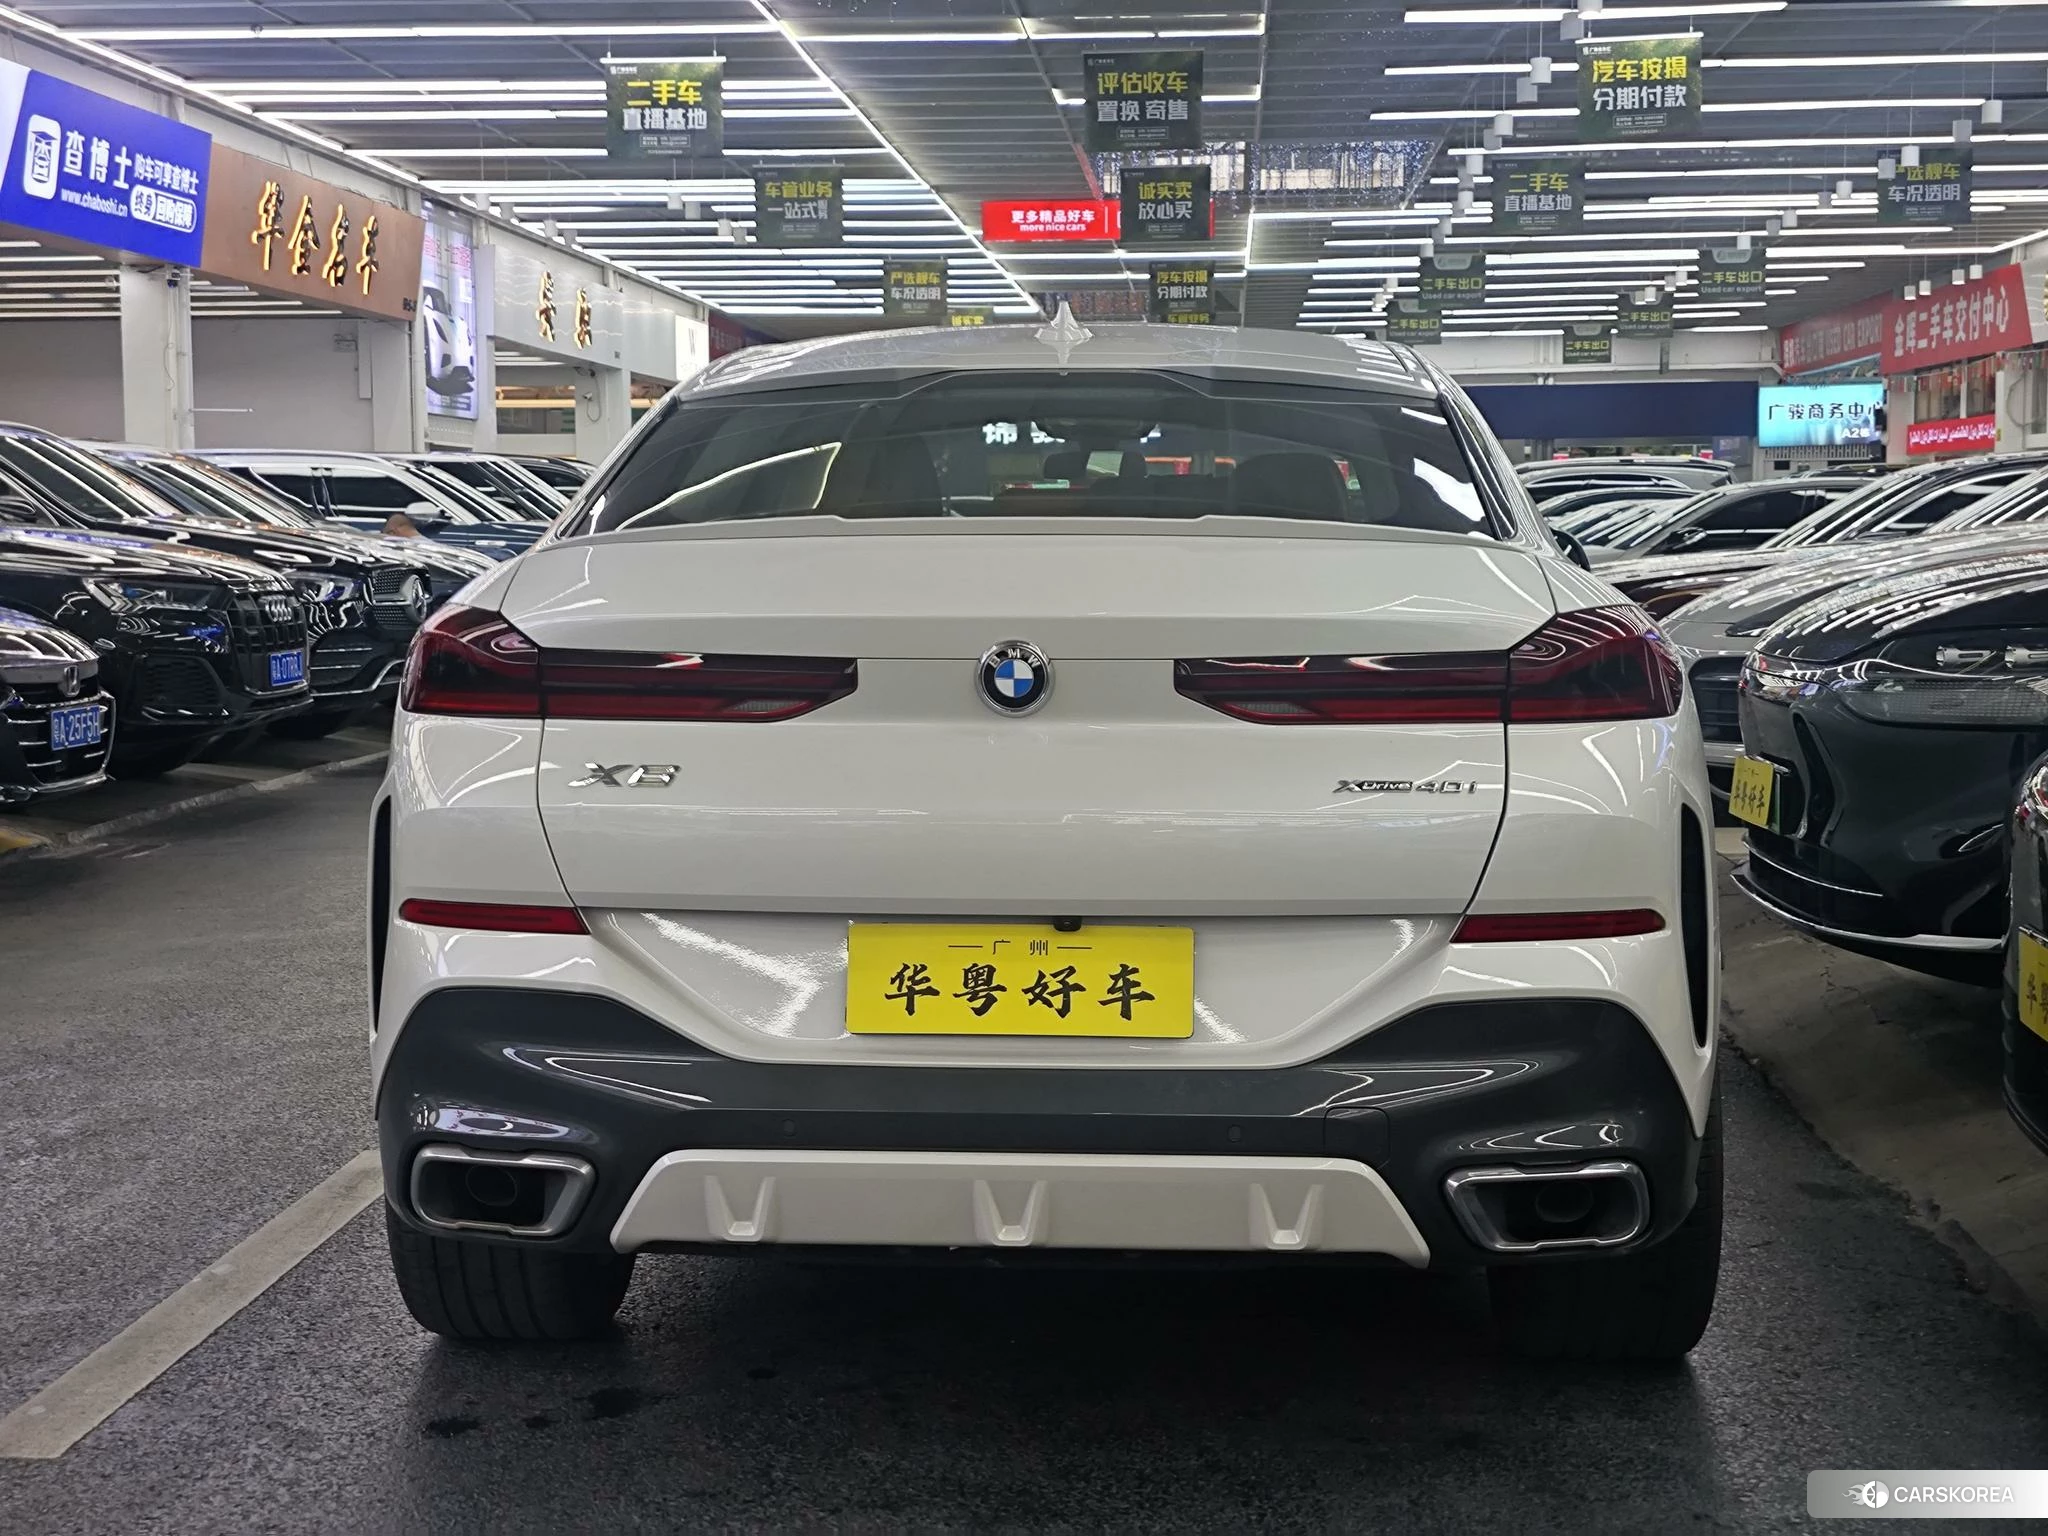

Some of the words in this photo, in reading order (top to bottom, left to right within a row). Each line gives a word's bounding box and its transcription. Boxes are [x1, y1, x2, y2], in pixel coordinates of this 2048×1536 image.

[1592, 56, 1687, 83] 汽车按揭
[1097, 71, 1189, 95] 评估收车
[626, 80, 702, 106] 二手车
[1592, 84, 1687, 111] 分期付款
[623, 108, 708, 131] 直播基地
[1097, 100, 1140, 122] 置换
[1145, 100, 1189, 121] 寄售
[63, 130, 132, 190] 查博士
[134, 153, 199, 196] 购车可享查博士
[1508, 173, 1569, 192] 二手车
[765, 181, 833, 198] 车管业务
[1138, 182, 1193, 200] 诚实卖
[1888, 183, 1961, 202] 车况透明
[61, 188, 128, 218] www.chaboshi.cn
[134, 190, 154, 216] 终身
[156, 194, 193, 228] 回购保障
[1138, 201, 1193, 220] 放心买
[1504, 194, 1572, 212] 直播基地
[1011, 210, 1095, 224] 更多精品好车
[1020, 224, 1044, 232] more
[1045, 223, 1066, 232] nice
[1066, 224, 1087, 232] cars
[1423, 277, 1482, 290] 二手车出口
[1702, 271, 1762, 283] 二手车出口
[1736, 286, 1762, 294] export
[1391, 319, 1439, 329] 二手车出口
[1621, 311, 1671, 322] 二手车出口
[1566, 340, 1609, 350] 二手车出口
[988, 648, 1041, 668] BMW
[567, 761, 681, 788] X6
[992, 939, 1049, 956] 广州
[885, 963, 1155, 1021] 华粤好车
